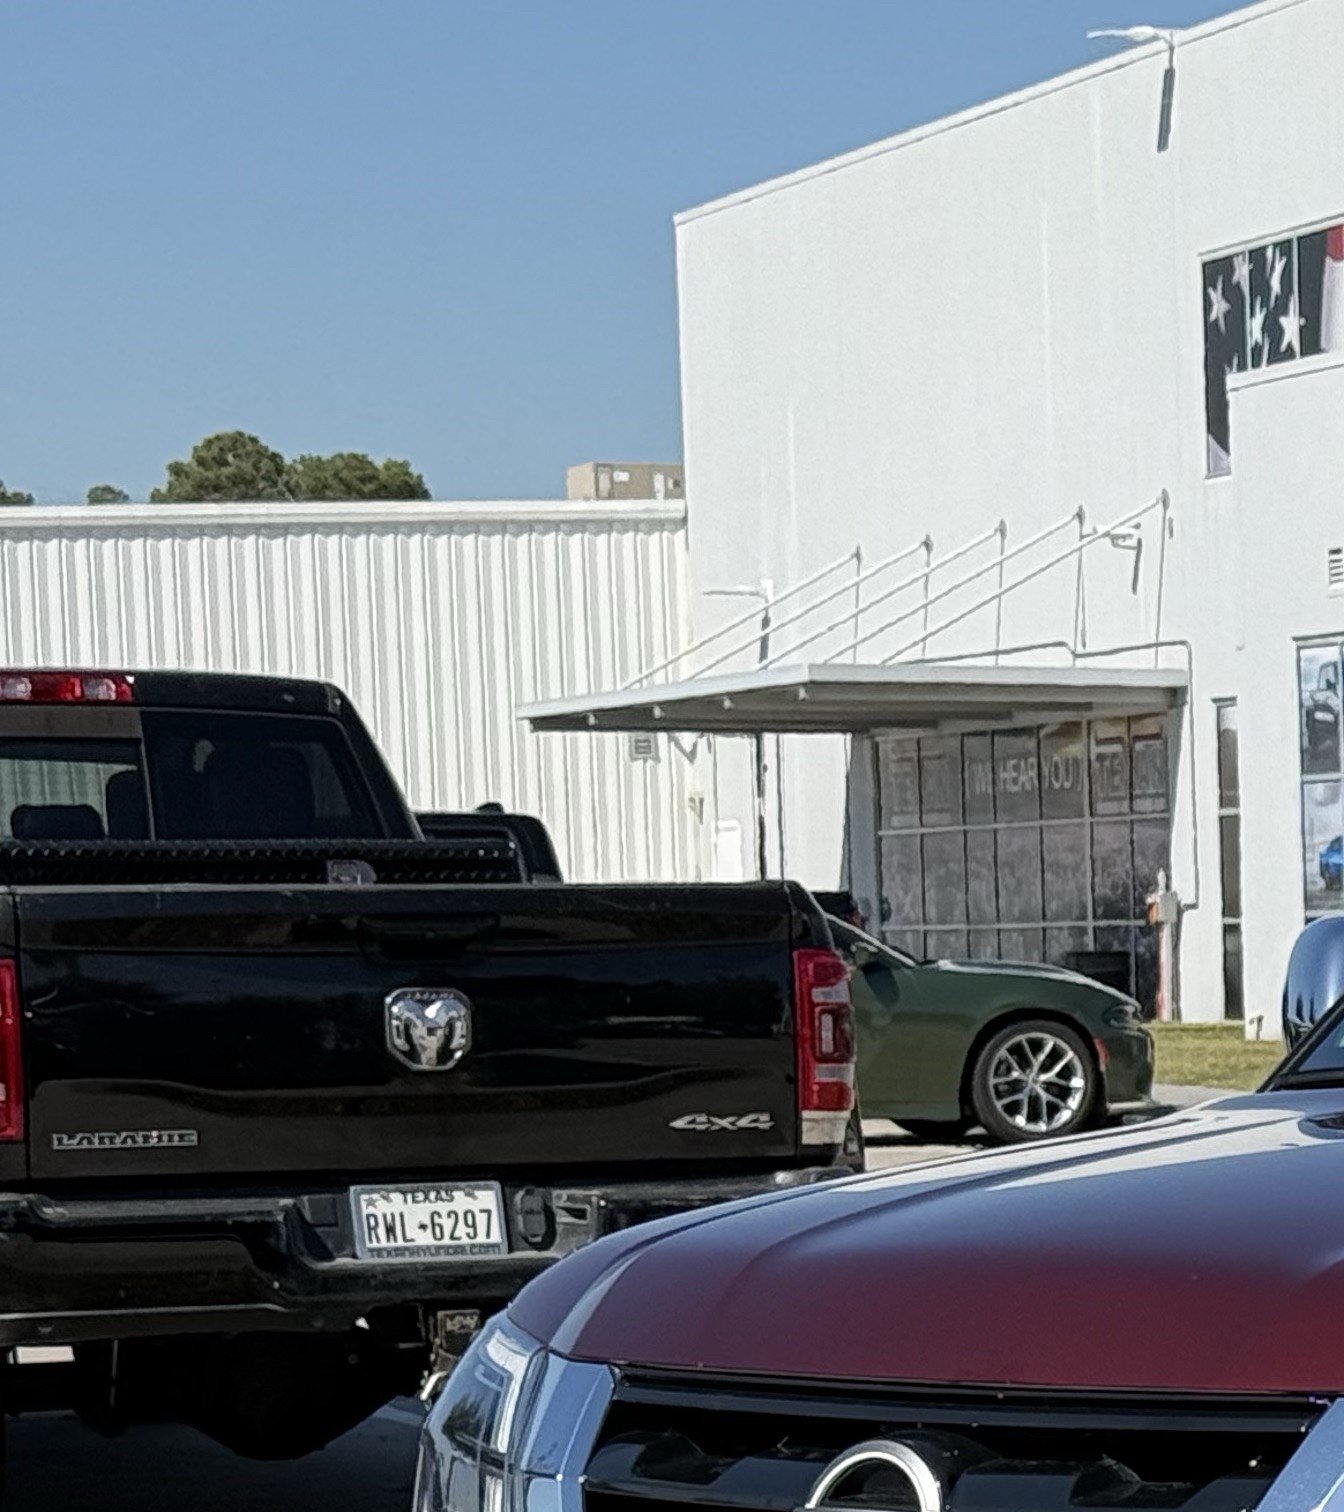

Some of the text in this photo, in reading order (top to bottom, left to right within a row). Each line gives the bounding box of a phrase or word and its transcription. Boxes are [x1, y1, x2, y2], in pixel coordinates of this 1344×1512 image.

[999, 757, 1040, 792] HEAR
[668, 1111, 775, 1131] 4x4
[401, 1189, 455, 1205] TEXAS
